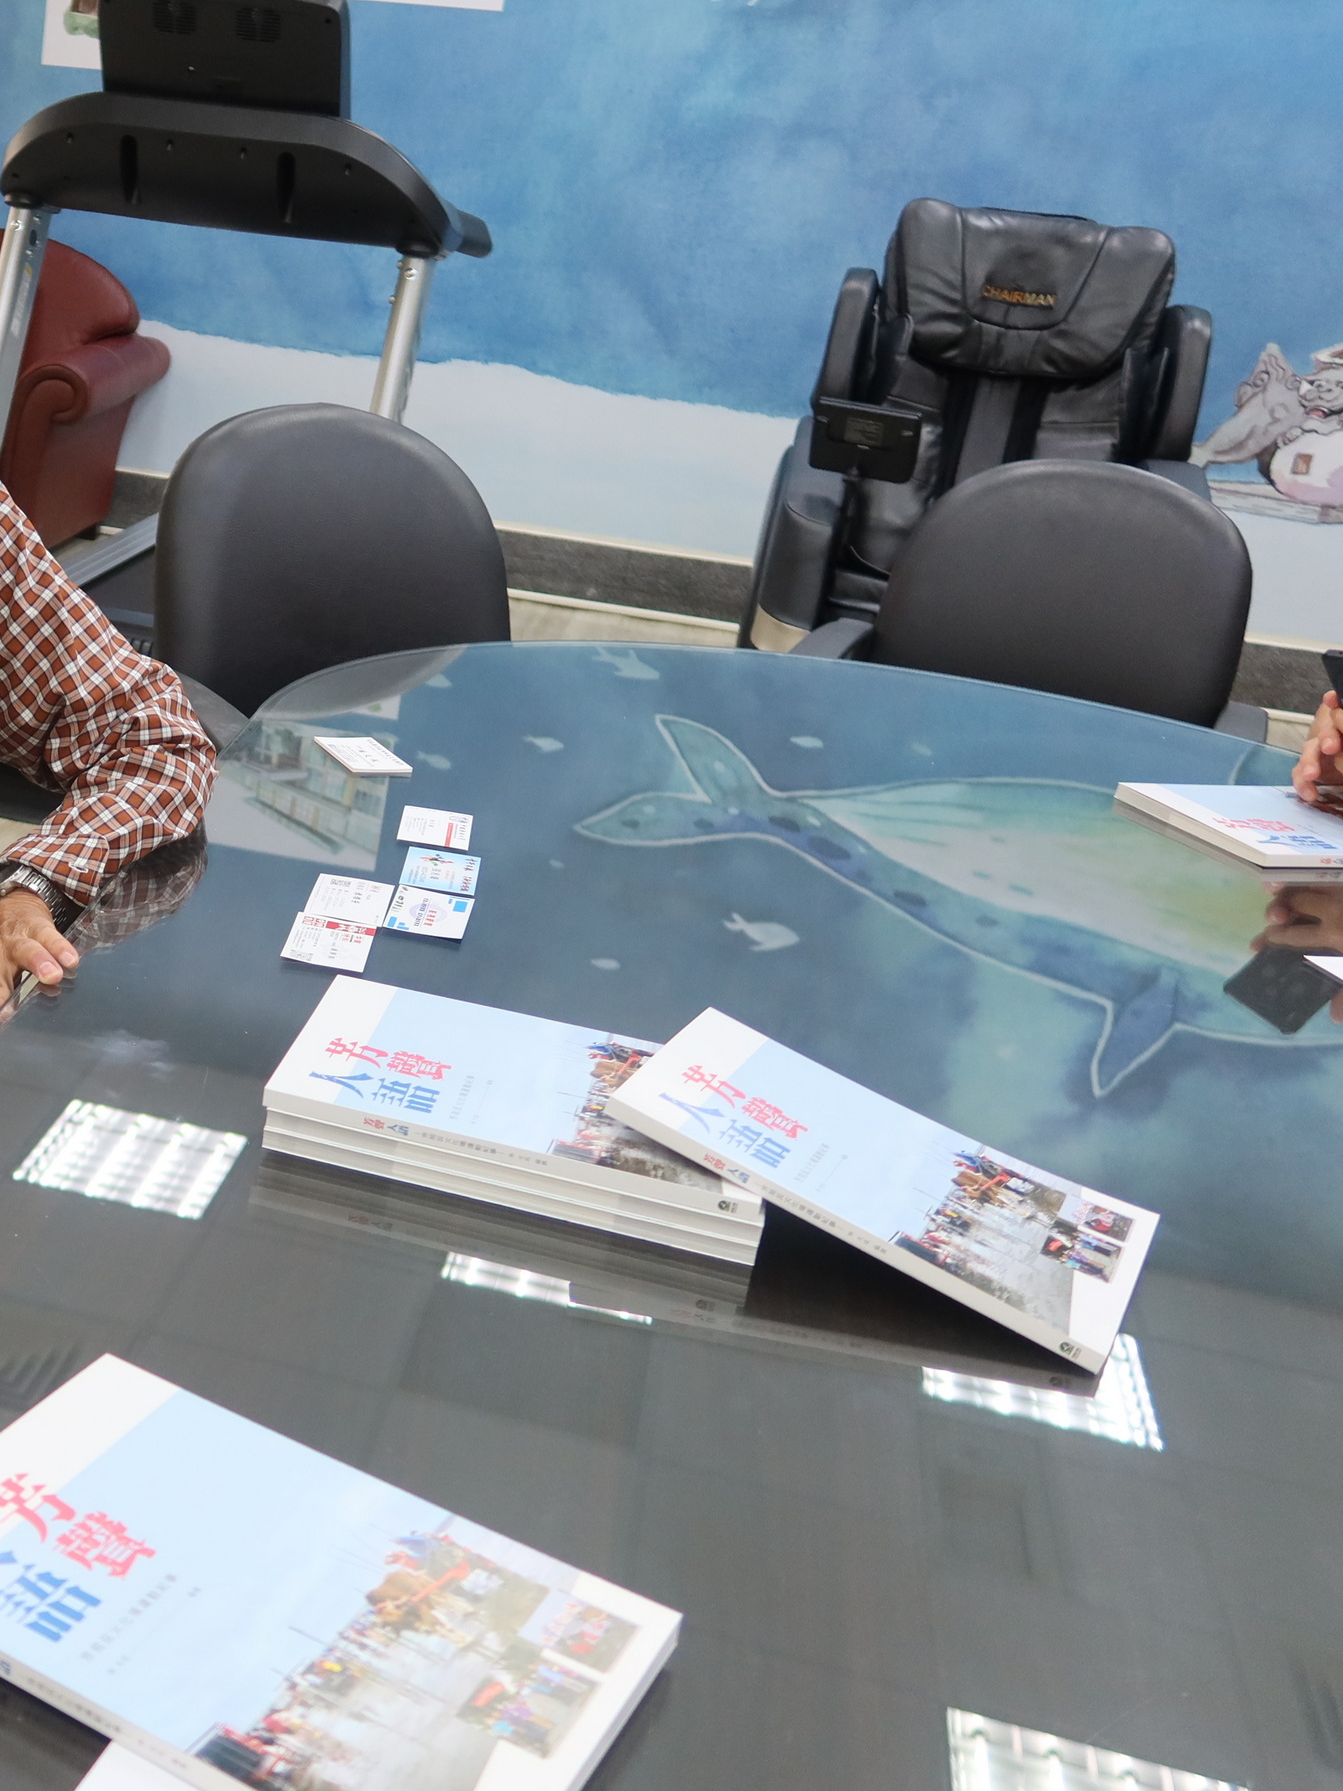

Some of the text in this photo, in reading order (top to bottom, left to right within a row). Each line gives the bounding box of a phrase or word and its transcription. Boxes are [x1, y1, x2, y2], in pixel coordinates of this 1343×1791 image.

[982, 285, 1055, 306] CHAIRMAN
[325, 1037, 453, 1081] 芳聲
[309, 1071, 441, 1114] 人語
[682, 1065, 809, 1140] 芳聲
[658, 1092, 791, 1169] 人語
